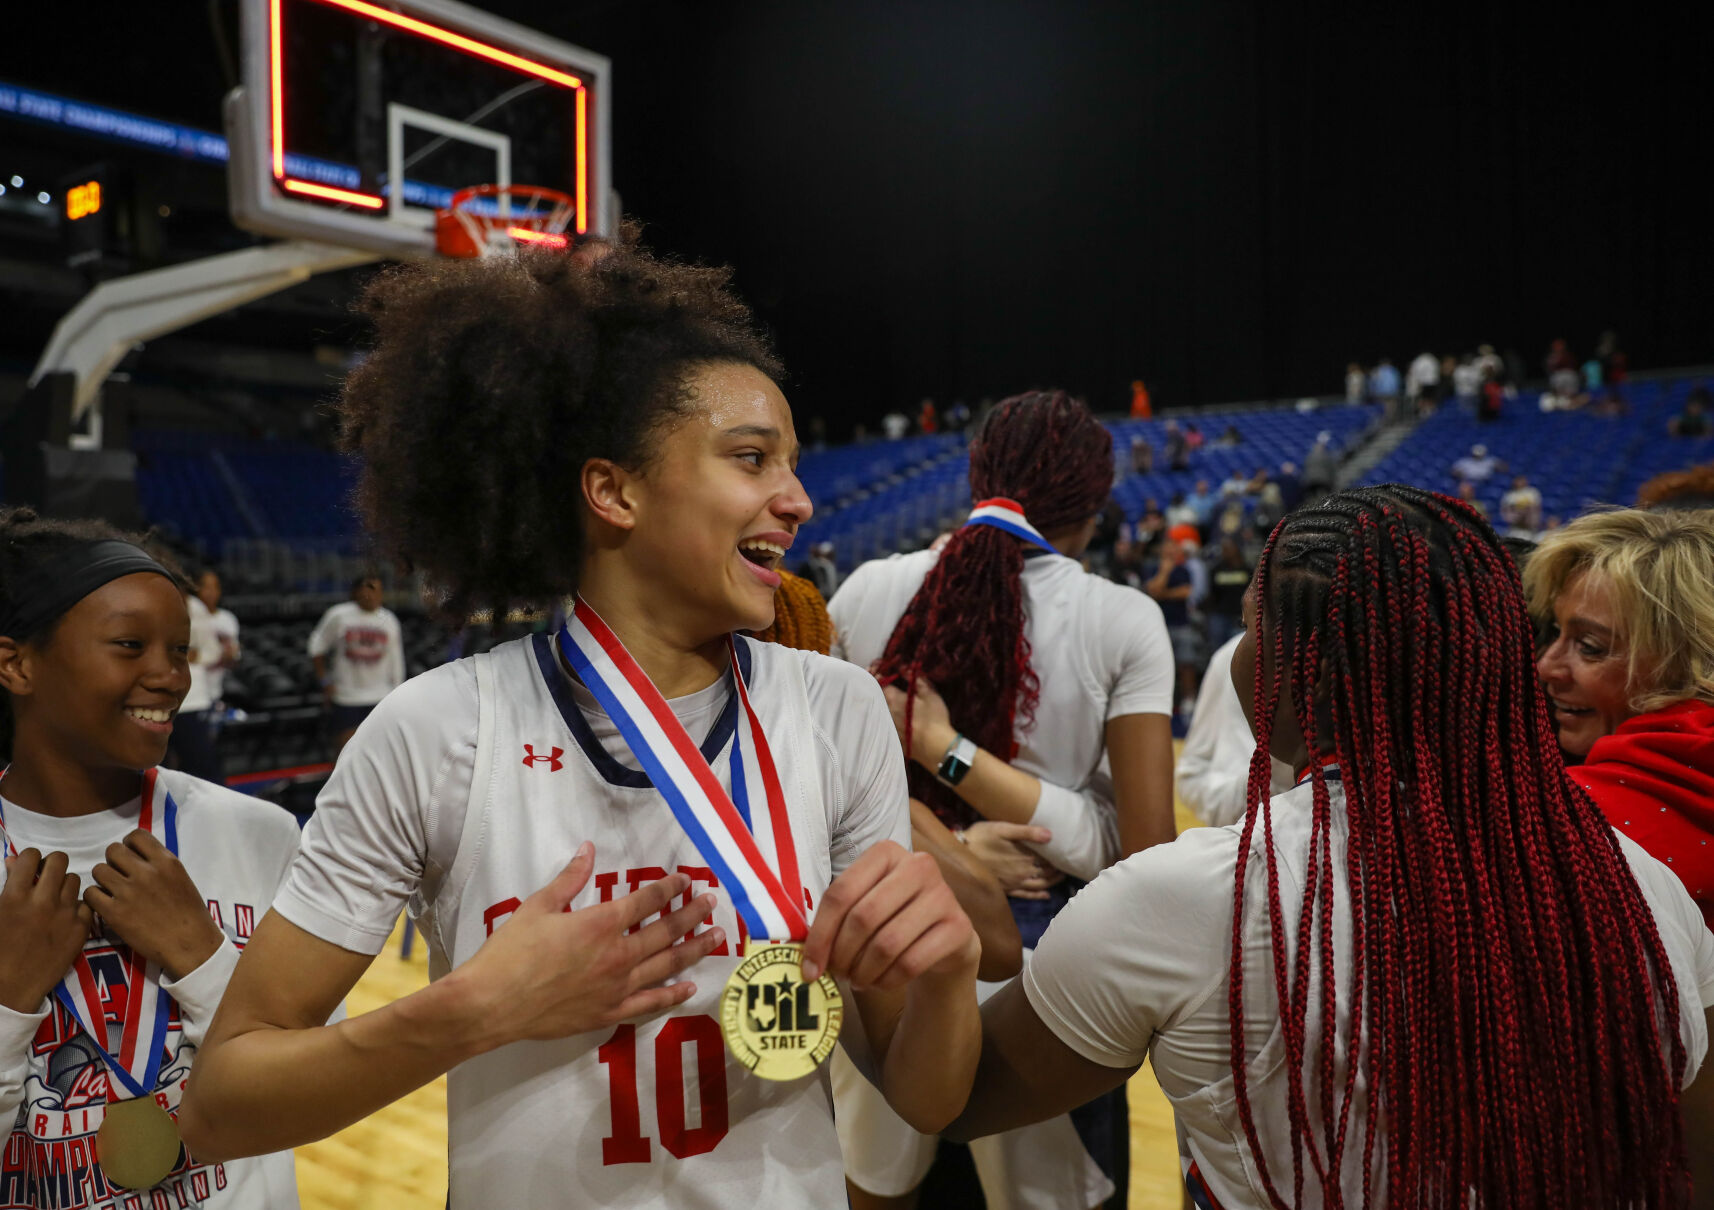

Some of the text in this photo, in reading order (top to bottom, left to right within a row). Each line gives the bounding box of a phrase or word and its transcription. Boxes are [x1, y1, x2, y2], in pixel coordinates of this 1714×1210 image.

[747, 983, 819, 1032] UIL
[760, 1034, 806, 1050] STATE
[34, 1079, 188, 1137] RAIR
[63, 1063, 107, 1110] La
[598, 1014, 728, 1166] 10
